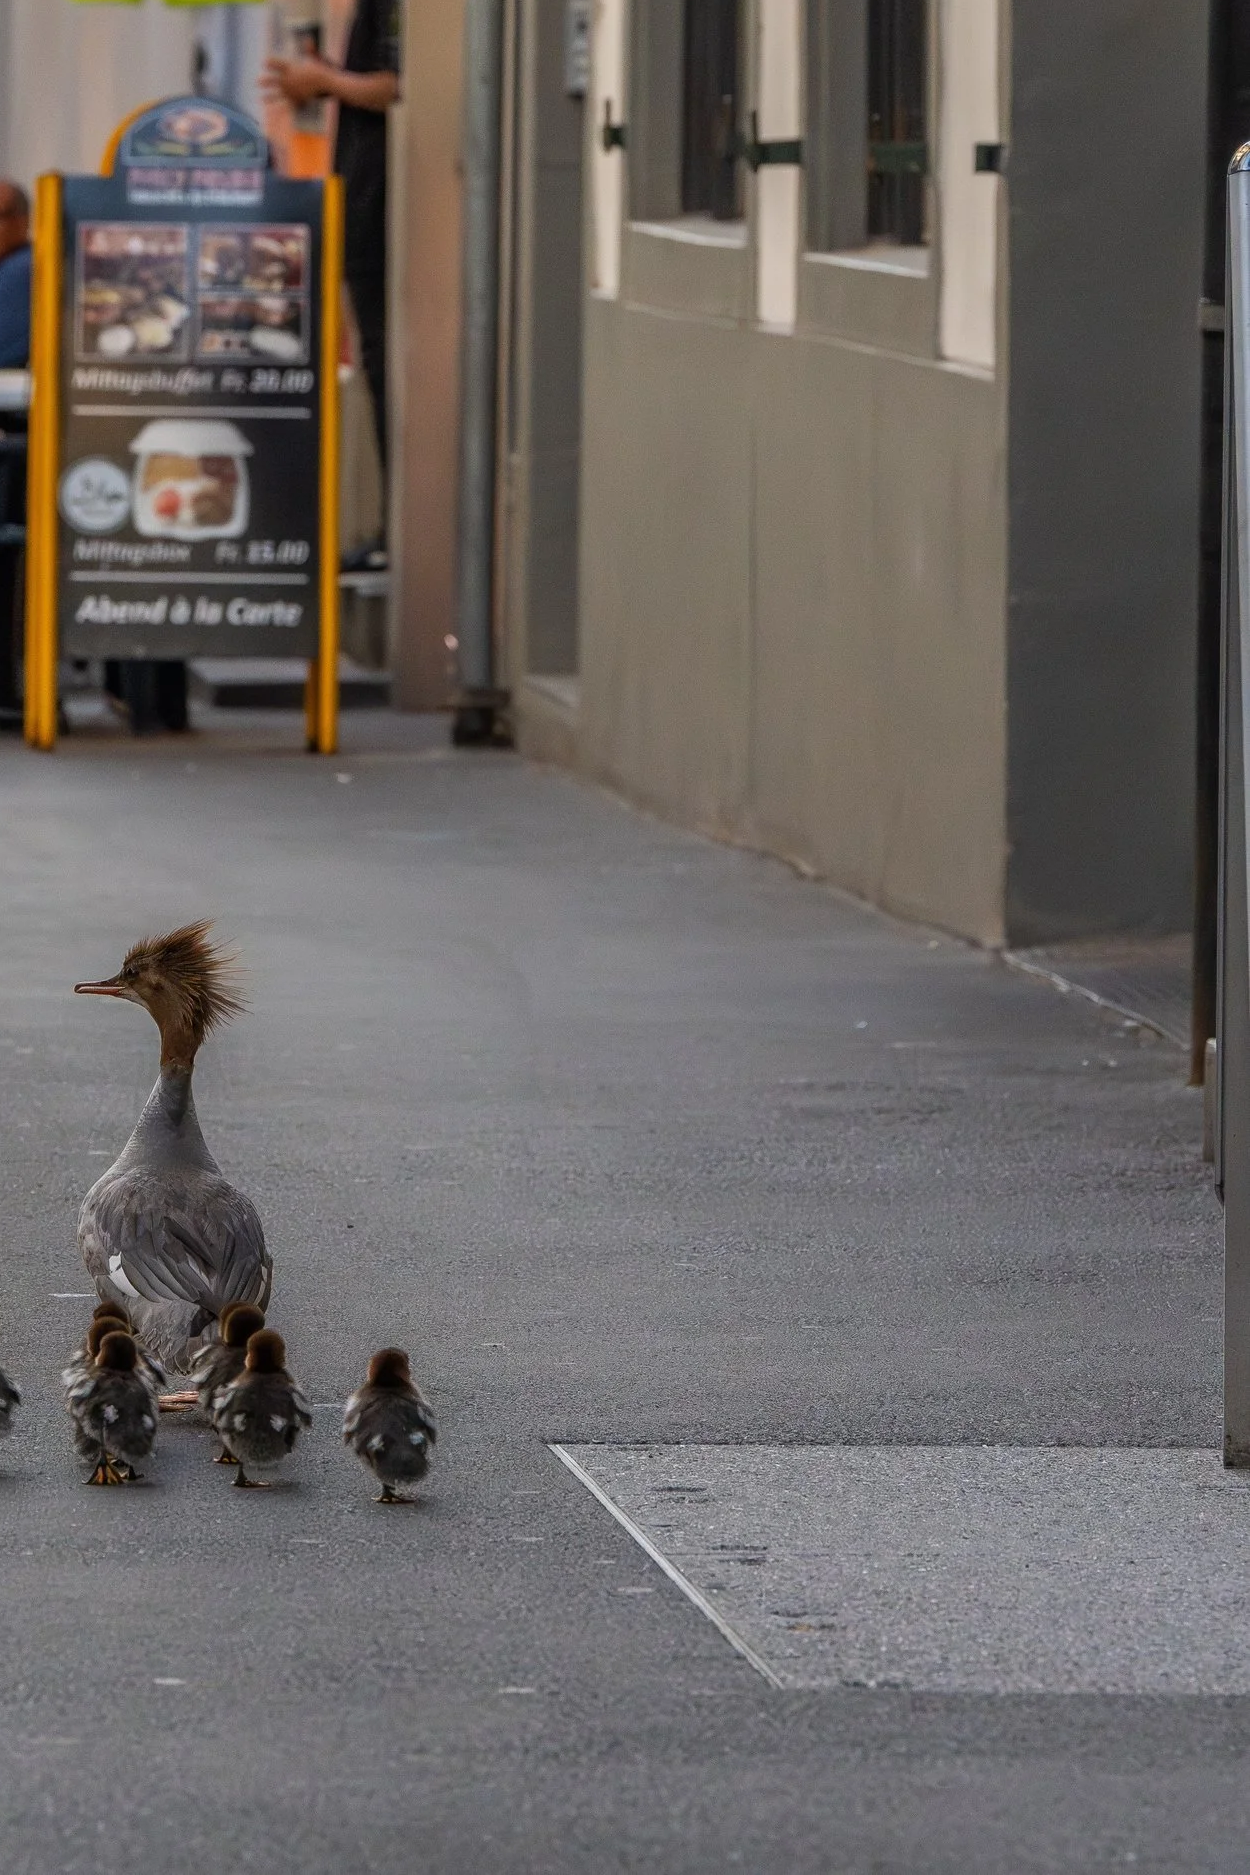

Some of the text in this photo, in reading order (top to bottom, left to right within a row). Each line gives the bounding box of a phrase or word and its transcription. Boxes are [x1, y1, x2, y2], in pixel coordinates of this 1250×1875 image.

[75, 594, 168, 625] Abend
[194, 595, 222, 625] la
[227, 597, 303, 626] Carte
